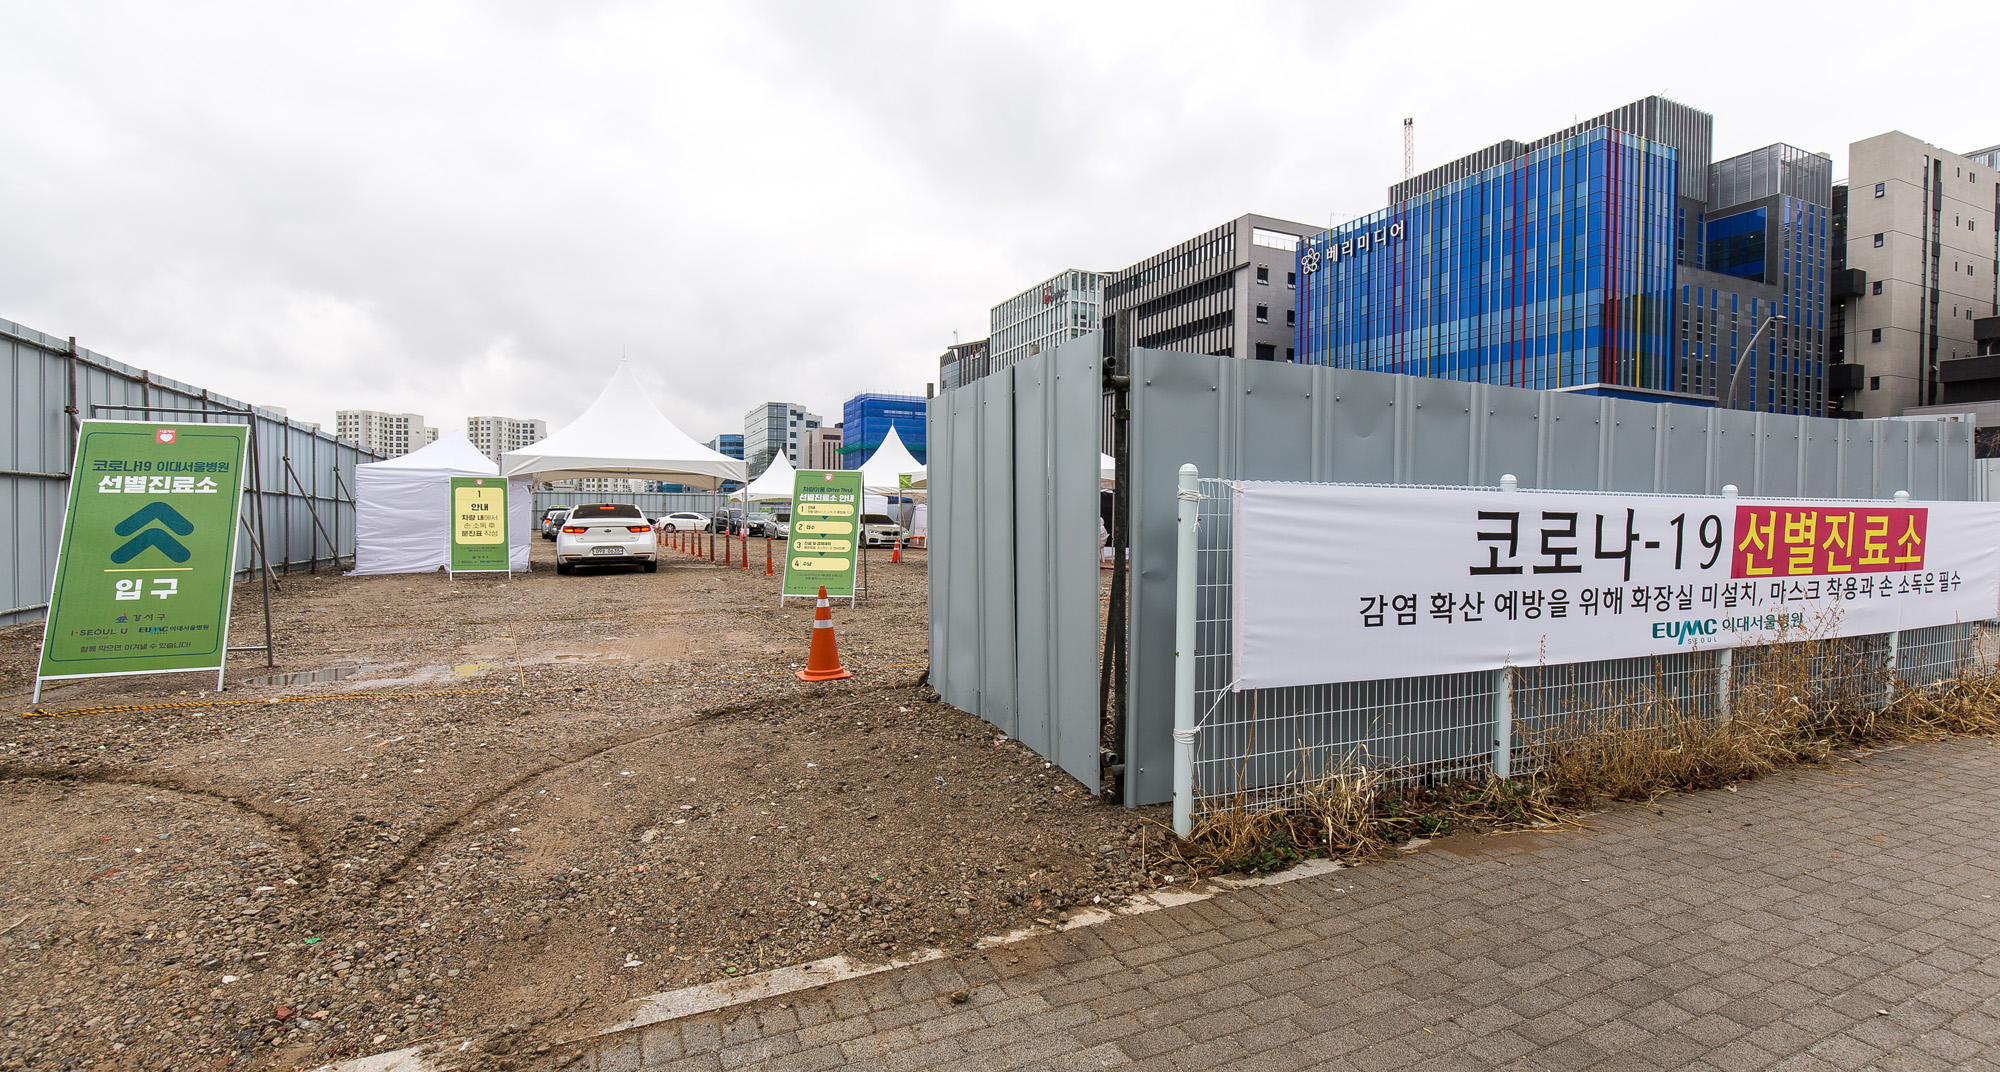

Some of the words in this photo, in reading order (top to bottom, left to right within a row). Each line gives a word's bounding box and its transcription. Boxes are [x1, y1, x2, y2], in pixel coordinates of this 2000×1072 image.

[1326, 220, 1404, 262] 베리미디어
[92, 460, 152, 472] 코로나19
[157, 460, 229, 473] 이대서울병원
[98, 475, 218, 494] 선별진료소
[477, 490, 481, 498] 1
[799, 493, 837, 502] 선별진료소
[839, 494, 855, 502] 안내
[471, 503, 489, 511] 안내
[798, 523, 803, 531] 2
[796, 541, 802, 549] 3
[1469, 507, 1723, 583] 코로나-19
[1738, 510, 1922, 576] 선별진료소
[1359, 593, 1418, 627] 감염
[1429, 591, 1485, 624] 확산
[1494, 588, 1570, 621] 예방을
[1578, 586, 1624, 617] 위해
[1630, 584, 1693, 613] 화장실
[1701, 580, 1764, 609] 미설치,
[1769, 579, 1821, 605] 마스크
[1825, 576, 1874, 601] 착용과
[1878, 574, 1893, 597] 손
[1897, 573, 1935, 596] 소독은
[1937, 570, 1962, 594] 필수
[170, 624, 209, 632] 이대서울병원
[1652, 618, 1718, 646] EUMC
[1687, 636, 1718, 645] SEOUL
[80, 645, 97, 653] 함께
[98, 644, 122, 652] 막으면
[124, 643, 148, 651] 이겨낼
[158, 641, 192, 649] 있습니다!
